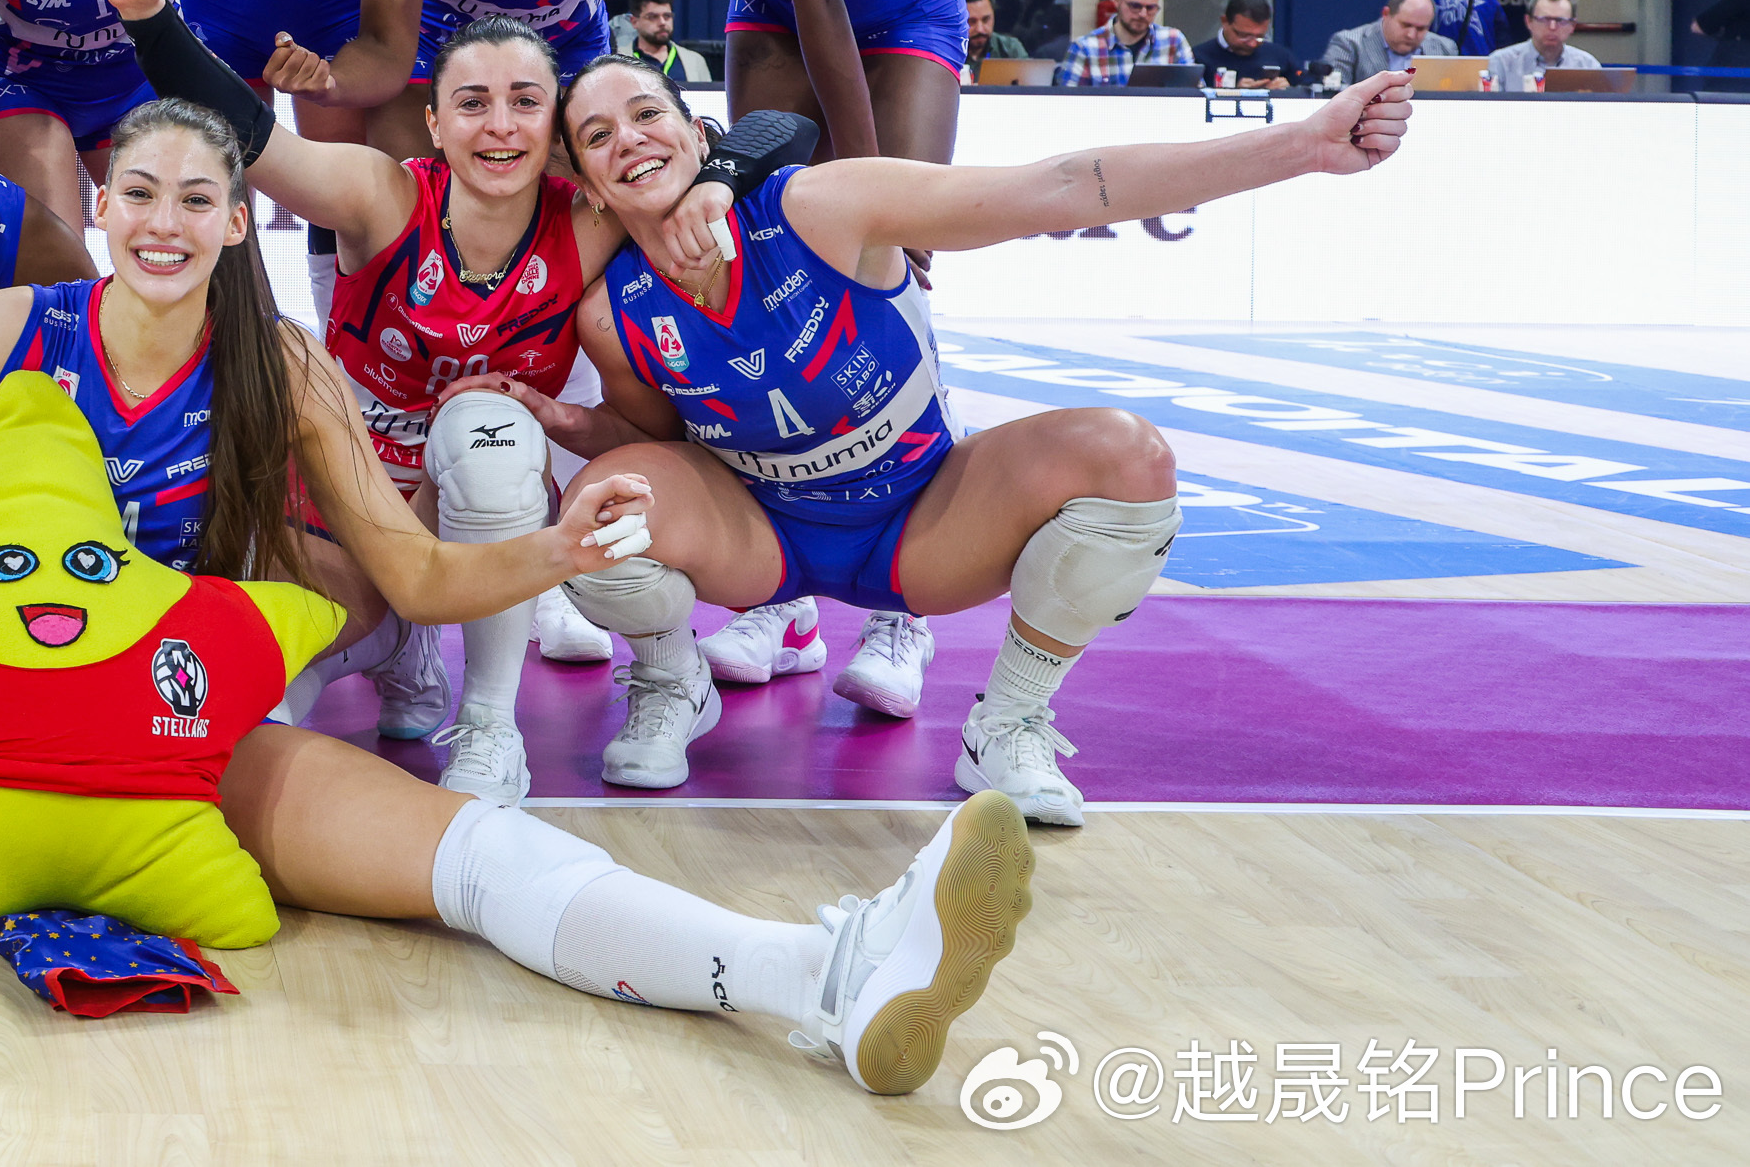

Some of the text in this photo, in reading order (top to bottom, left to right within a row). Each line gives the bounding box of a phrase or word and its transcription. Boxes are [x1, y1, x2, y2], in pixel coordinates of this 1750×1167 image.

[749, 224, 785, 242] KGM
[762, 268, 809, 313] mauden
[495, 293, 559, 338] FREDDY
[783, 295, 830, 364] FREDDY
[363, 363, 409, 401] bluemers
[836, 348, 871, 385] SKIN
[846, 360, 877, 397] LABO
[766, 387, 816, 440] 4
[468, 437, 517, 451] MIZUNO
[789, 418, 895, 478] numia
[150, 715, 210, 740] STELLARS
